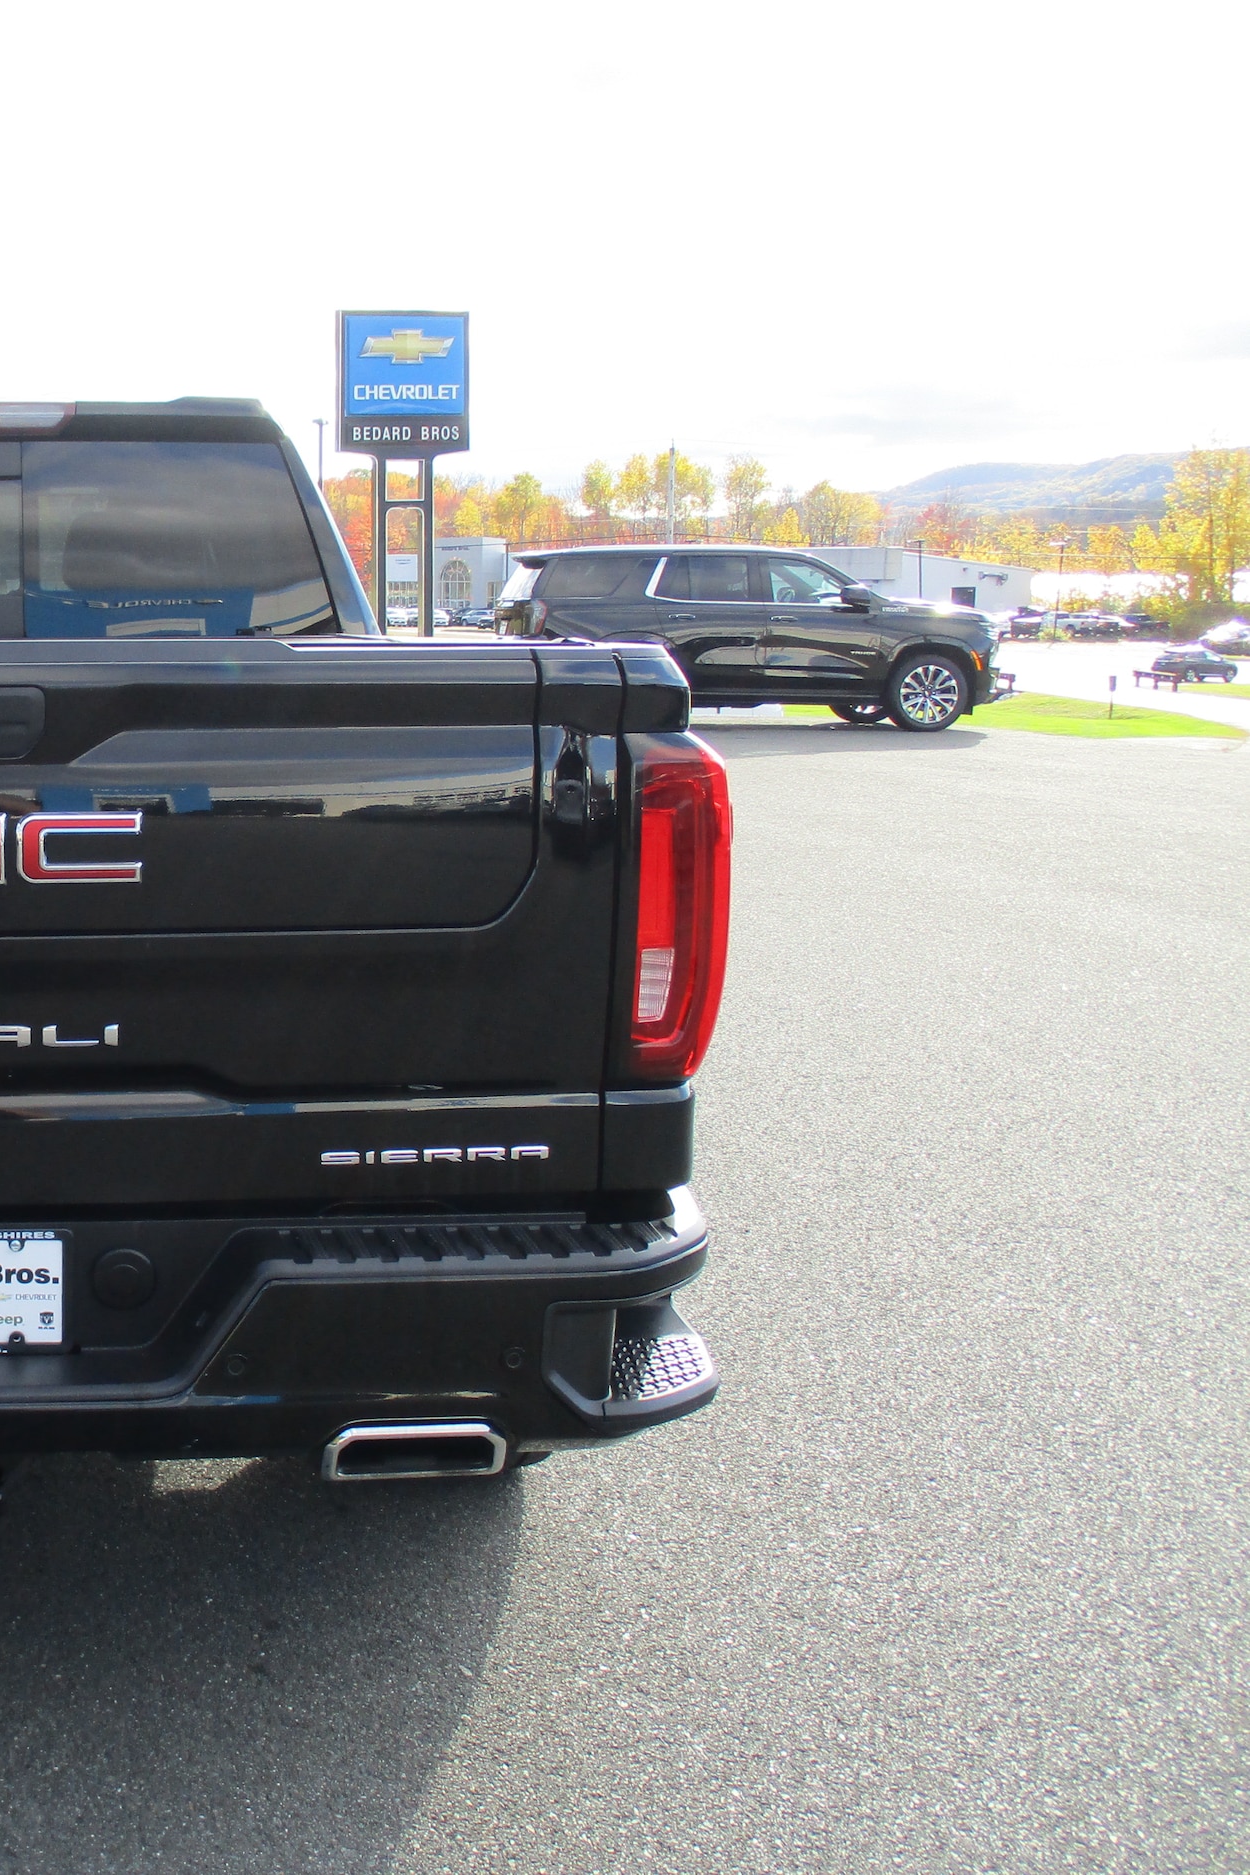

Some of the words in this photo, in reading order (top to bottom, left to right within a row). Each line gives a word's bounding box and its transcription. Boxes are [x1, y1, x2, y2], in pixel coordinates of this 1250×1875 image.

[353, 384, 460, 400] CHEVROLET
[352, 426, 411, 441] BEDARD
[421, 425, 460, 440] BROS
[320, 1144, 549, 1165] SIERRA
[15, 1293, 57, 1301] CHEVROLET
